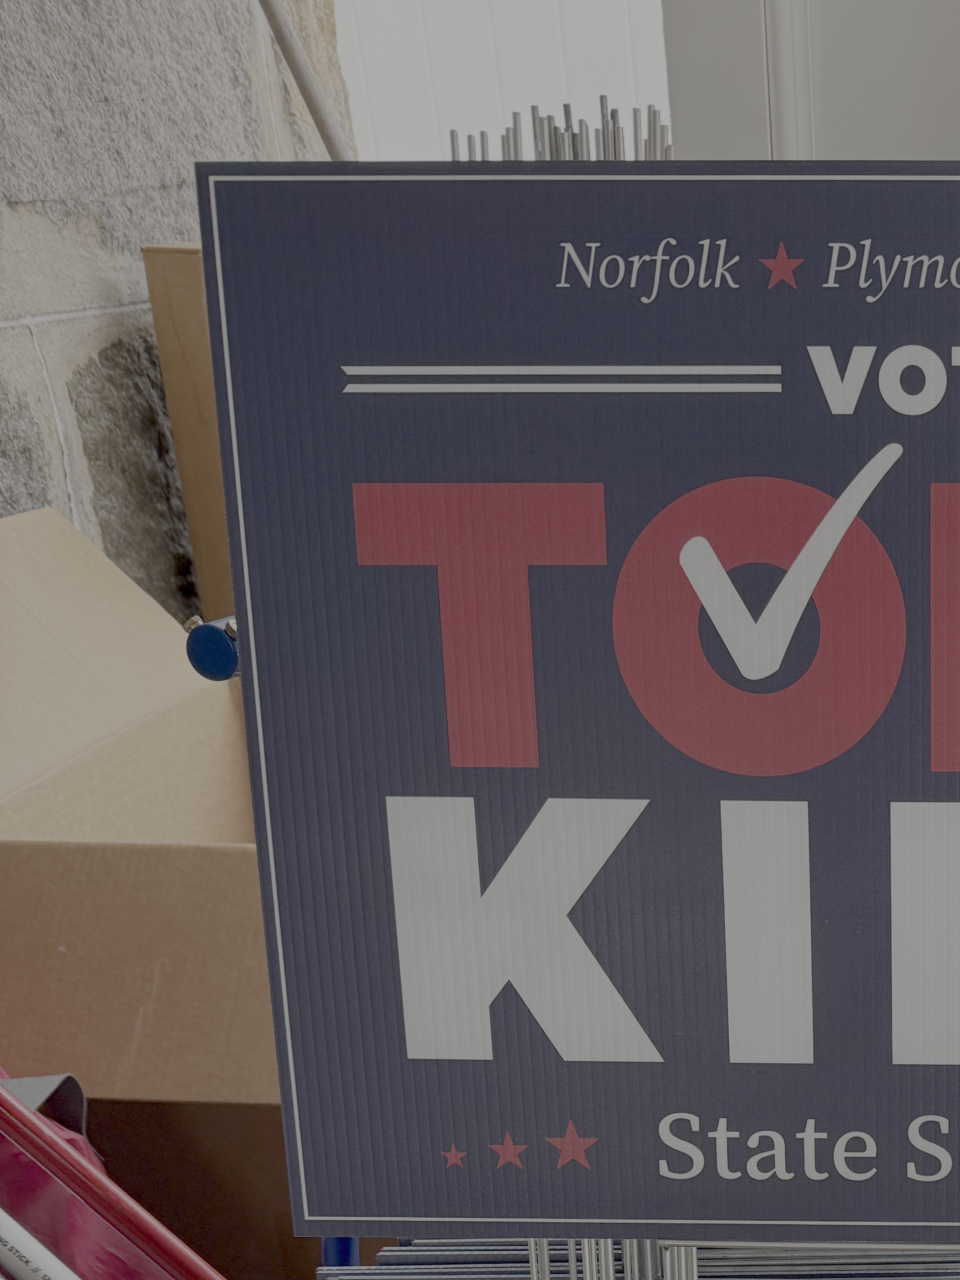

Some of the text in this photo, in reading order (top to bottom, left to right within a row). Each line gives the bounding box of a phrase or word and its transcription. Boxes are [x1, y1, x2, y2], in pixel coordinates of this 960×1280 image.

[555, 238, 741, 304] Norfolk
[656, 1111, 878, 1184] State
[8, 1245, 32, 1266] STICK
